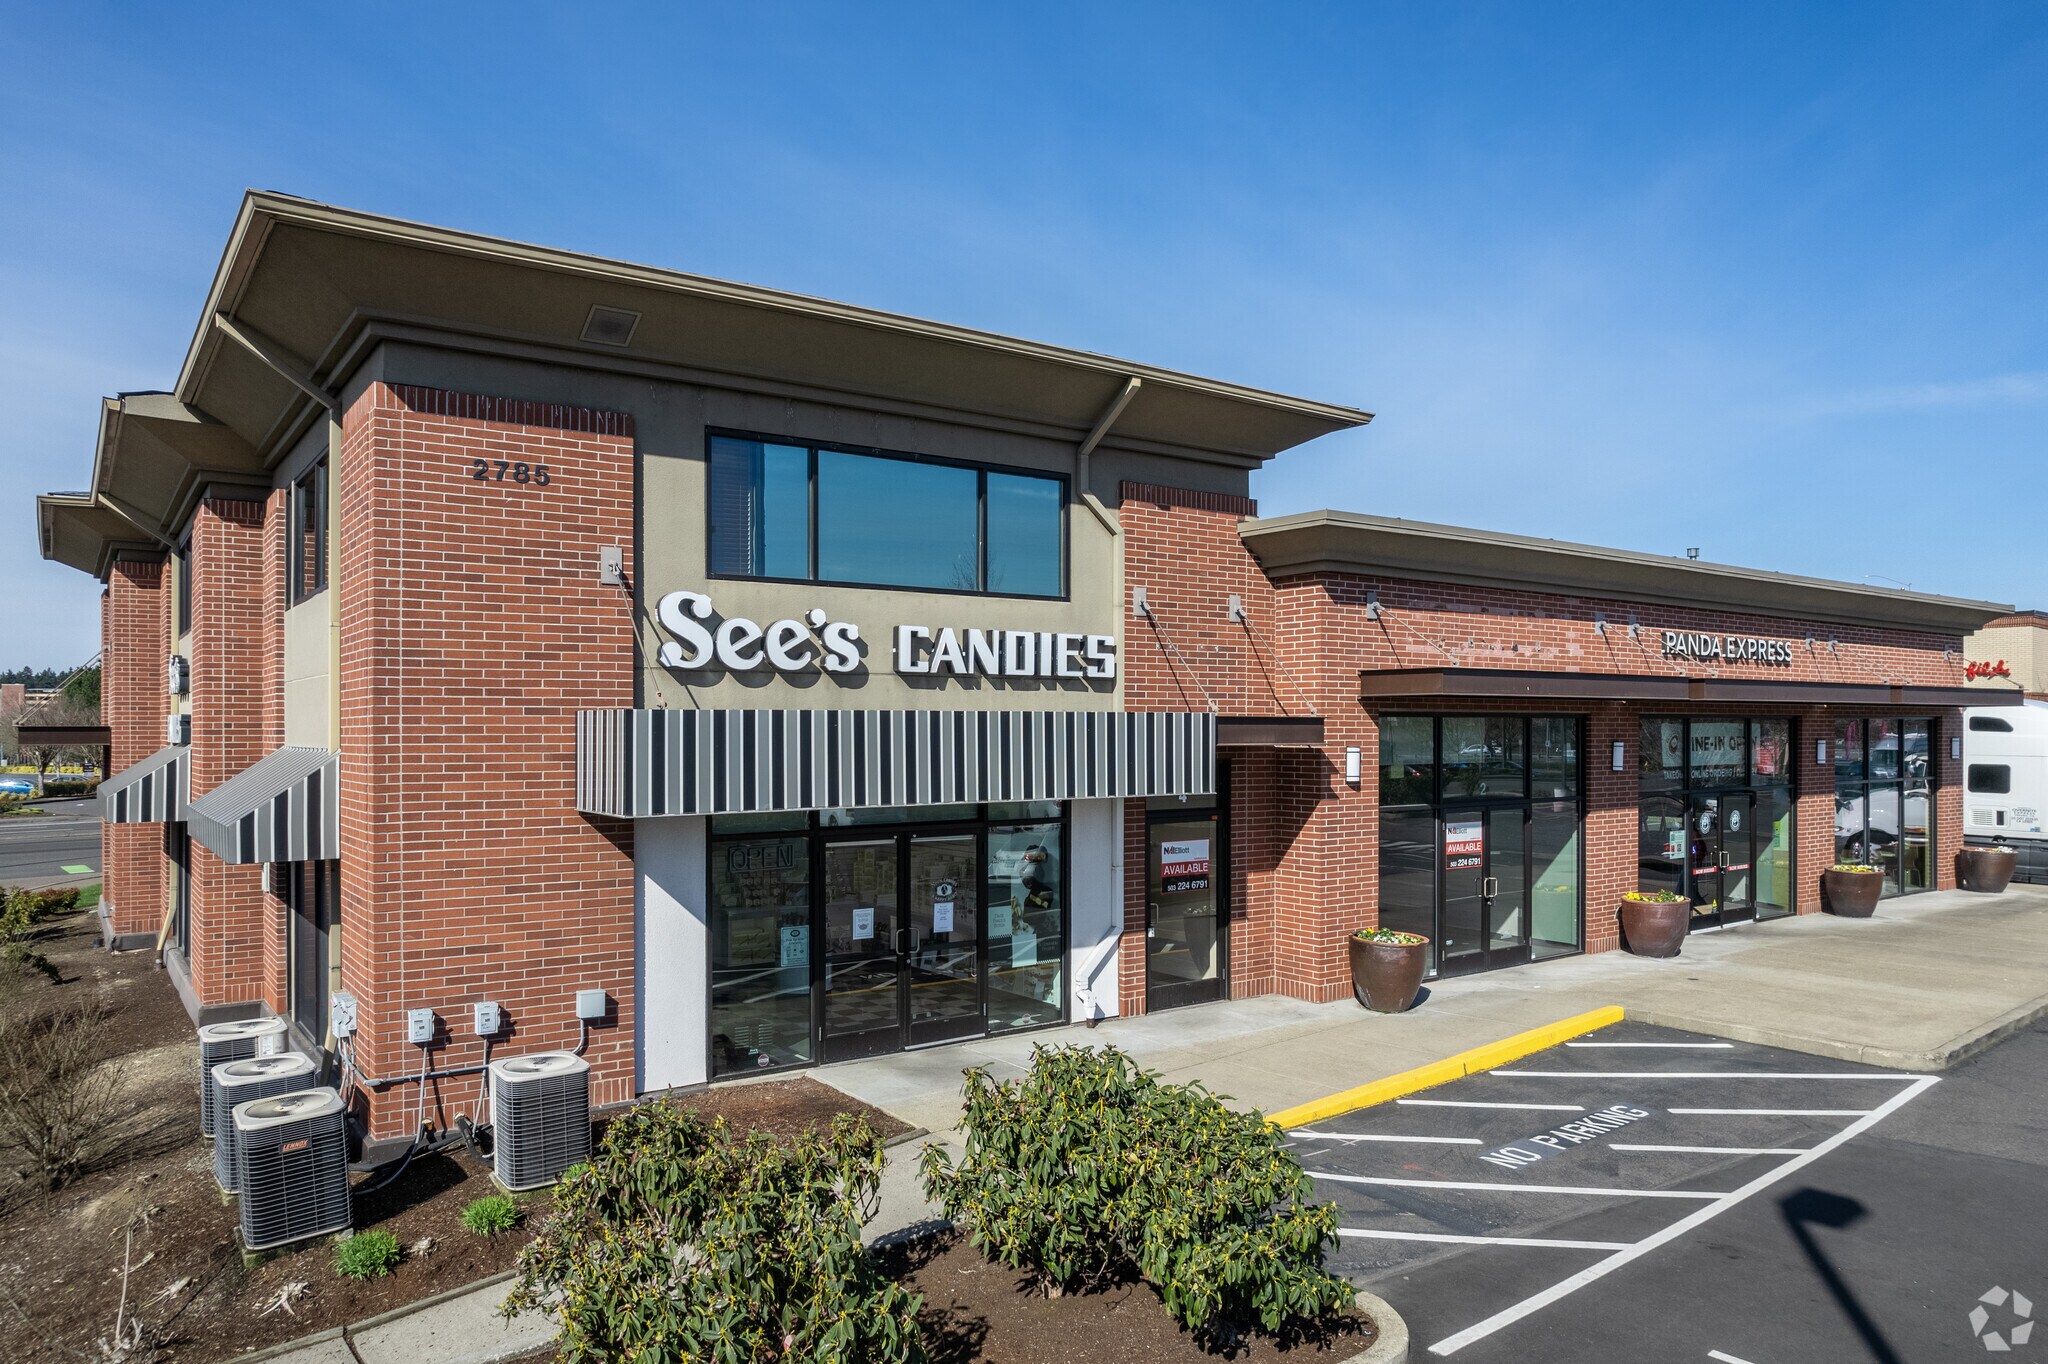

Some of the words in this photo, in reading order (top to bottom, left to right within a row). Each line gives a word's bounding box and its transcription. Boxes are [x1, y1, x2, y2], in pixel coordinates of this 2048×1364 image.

[473, 459, 551, 486] 2785
[656, 590, 860, 673] See's
[893, 625, 1117, 678] CANDIES
[1664, 631, 1722, 657] PANDA
[1725, 637, 1793, 661] EXPRESS
[1689, 735, 1726, 752] INE-IN
[1729, 735, 1758, 752] OPN
[1480, 782, 1487, 796] 2
[731, 845, 793, 870] OPEN
[1448, 842, 1481, 853] AVAILABLE
[1163, 862, 1208, 875] AVAILABLE
[1177, 881, 1190, 890] 224
[1191, 880, 1208, 889] 6791
[1478, 1146, 1542, 1170] NO
[1529, 1104, 1651, 1151] PARKING
